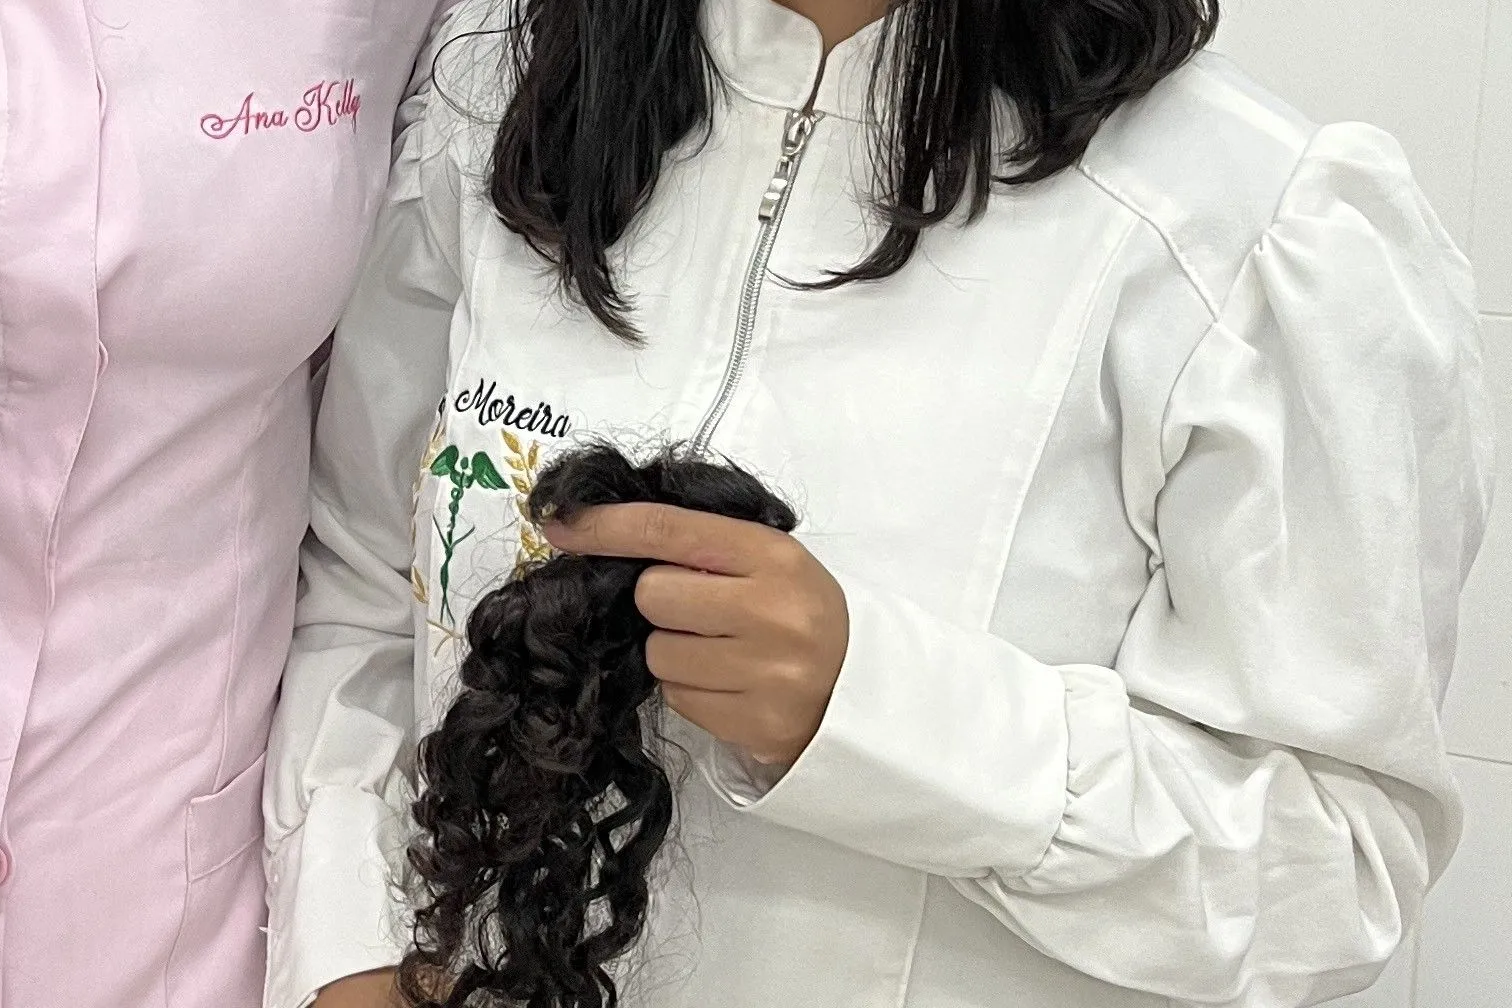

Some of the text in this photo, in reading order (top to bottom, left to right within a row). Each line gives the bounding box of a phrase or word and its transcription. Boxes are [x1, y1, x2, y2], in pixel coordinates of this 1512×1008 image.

[200, 78, 360, 139] Ana Kelly
[454, 377, 572, 438] Moreira
